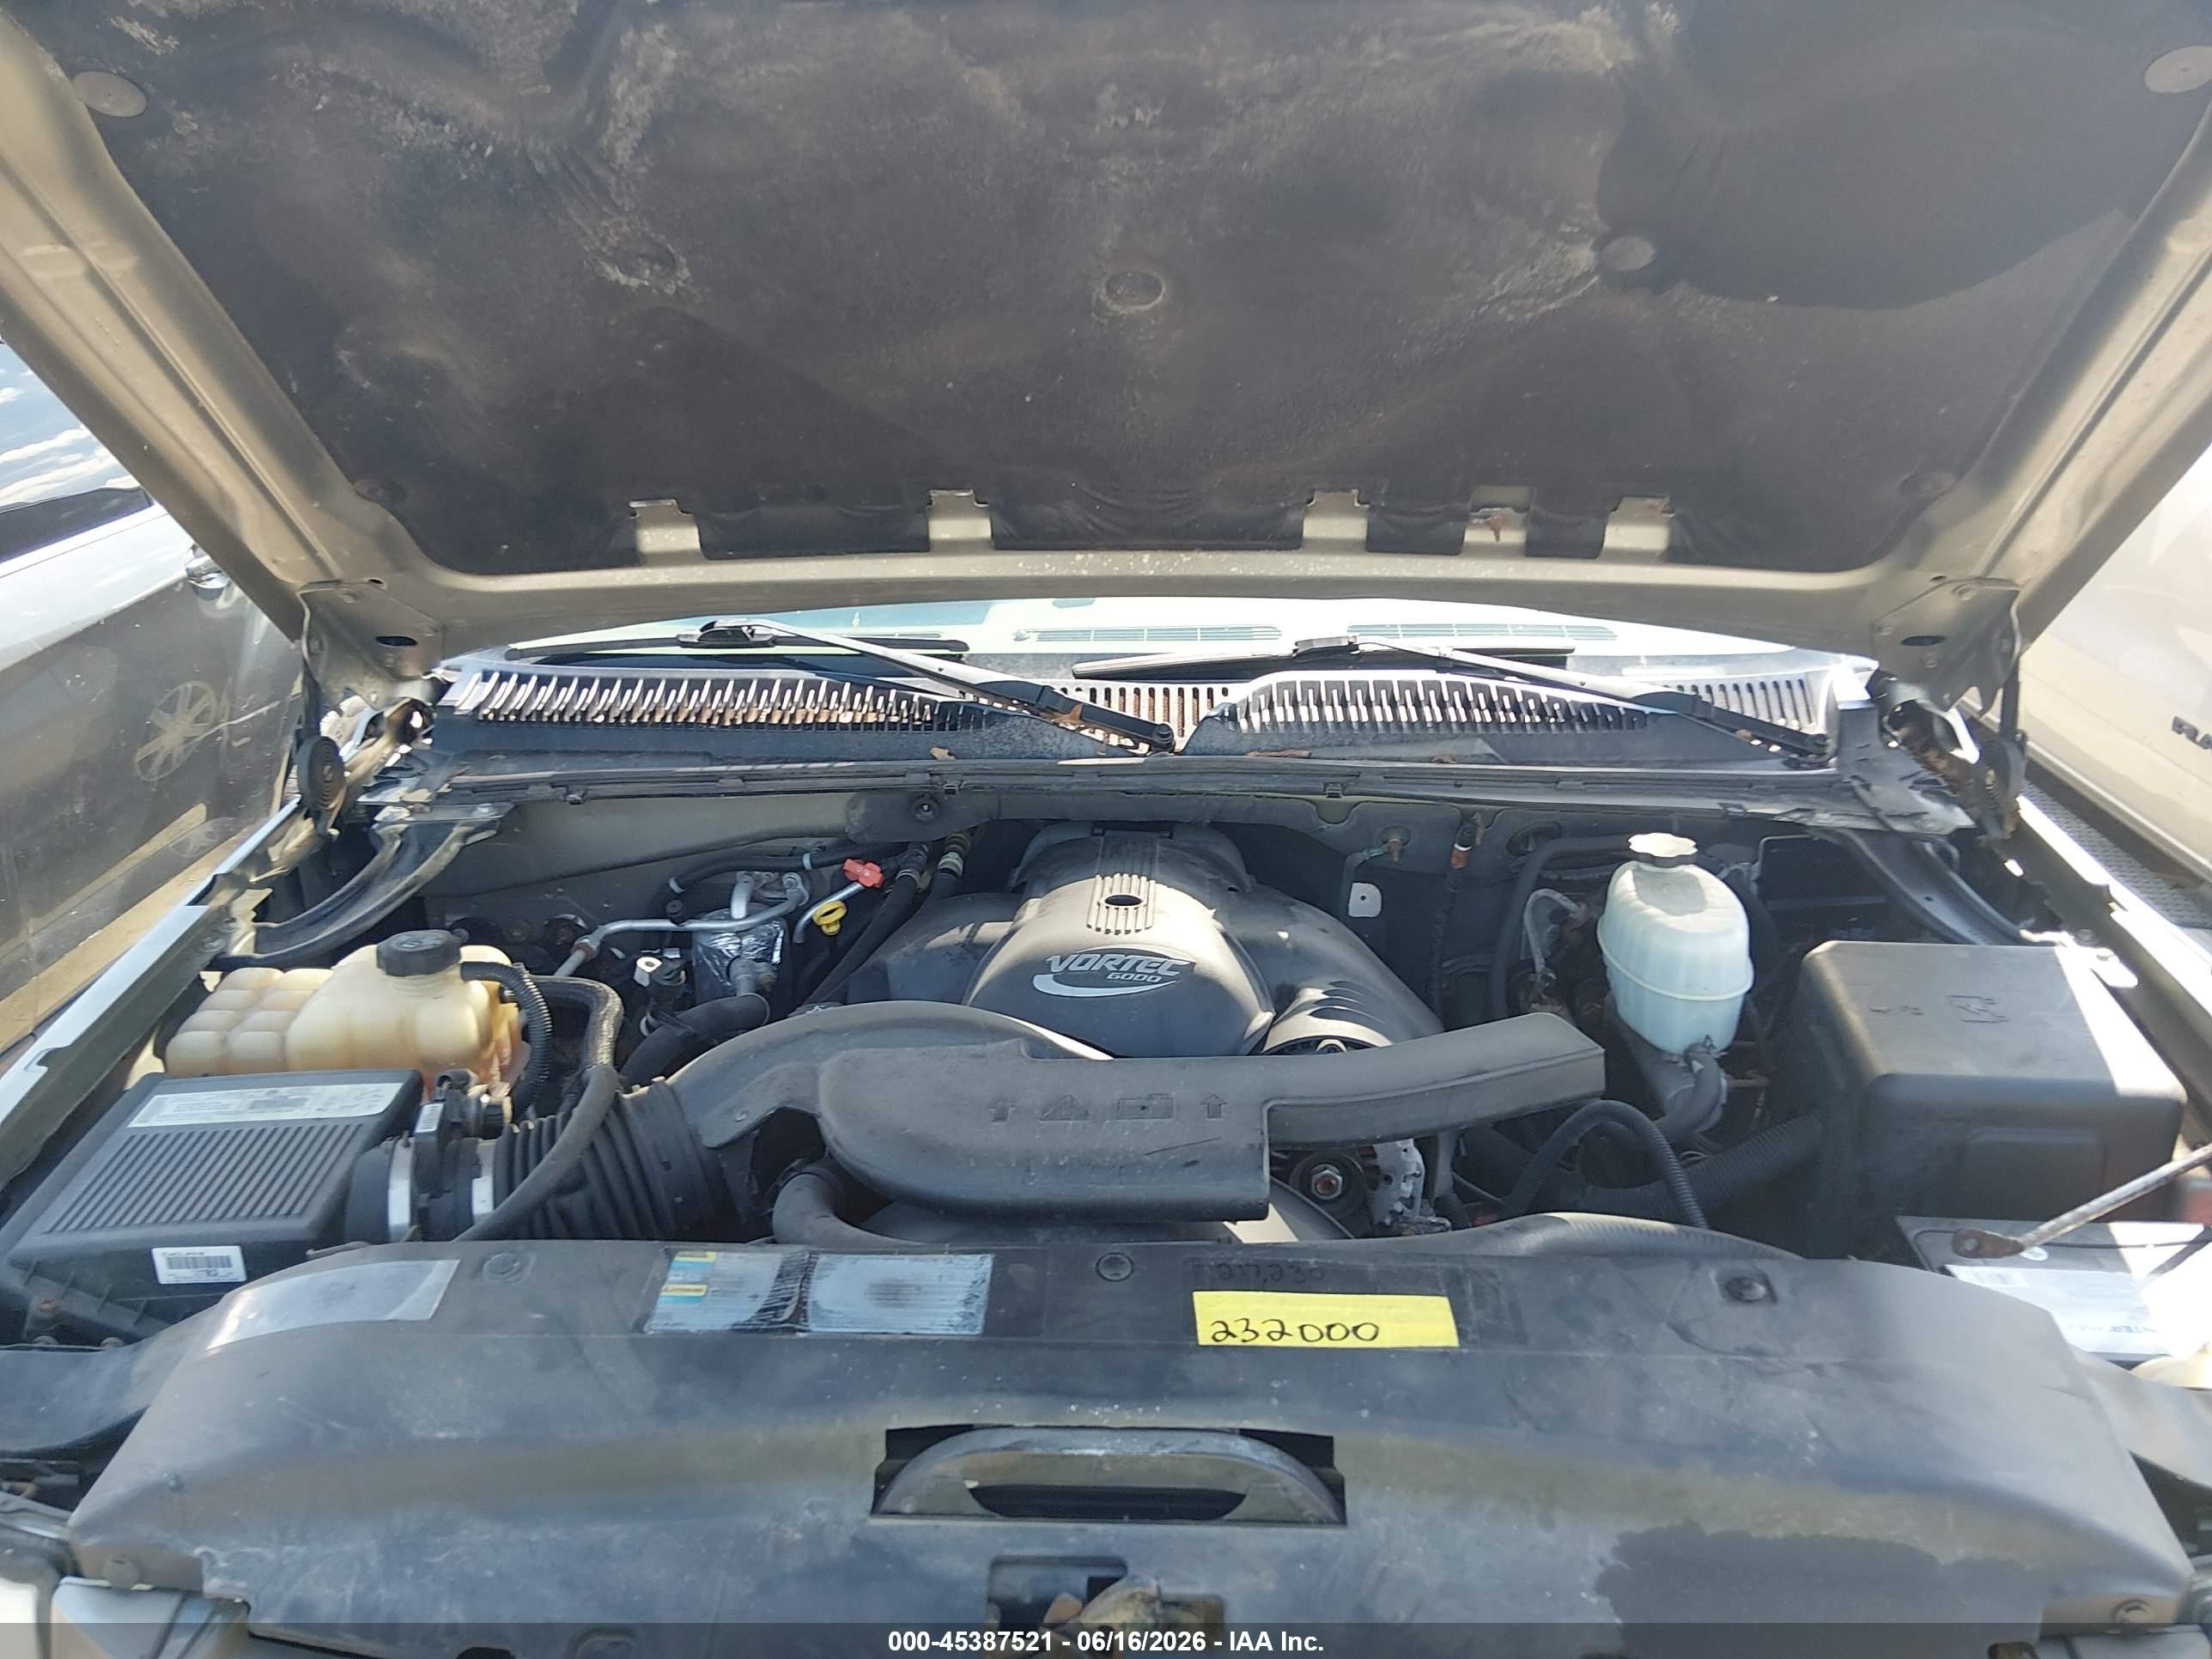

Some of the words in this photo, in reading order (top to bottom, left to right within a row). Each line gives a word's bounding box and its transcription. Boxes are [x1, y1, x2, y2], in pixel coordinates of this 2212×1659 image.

[1045, 953, 1192, 977] VORTEC
[1106, 972, 1163, 983] 6000
[1209, 1316, 1382, 1343] 232000
